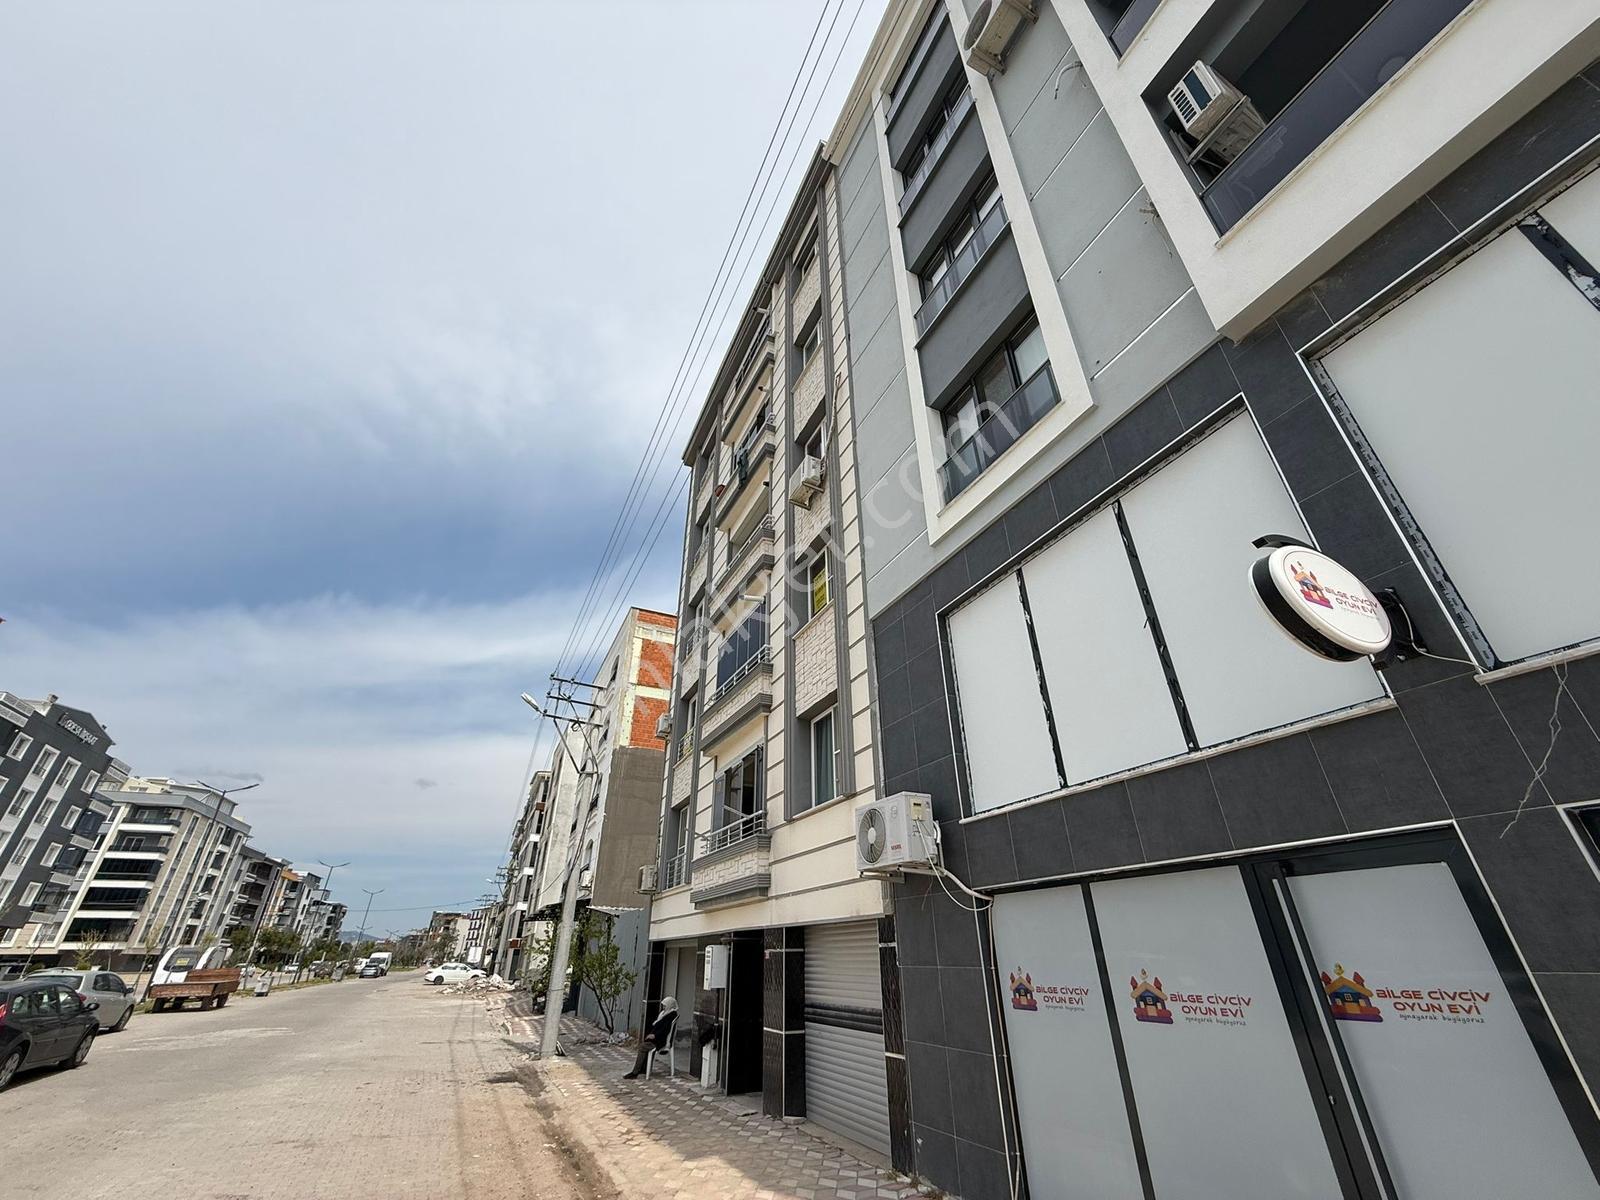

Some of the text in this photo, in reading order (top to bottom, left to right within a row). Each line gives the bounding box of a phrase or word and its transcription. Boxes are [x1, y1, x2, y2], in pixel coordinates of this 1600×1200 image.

[1335, 597, 1361, 611] OYUN
[1035, 984, 1089, 996] BİLGE CİVCİV
[1375, 987, 1491, 1003] BİLGE CİVCİV
[1043, 995, 1084, 1005] OYUN EVİ
[1169, 991, 1252, 1007] BİLGE CİVCİV
[1181, 1005, 1244, 1018] OYUN EVİ
[1393, 1001, 1481, 1015] OYUN EVİ
